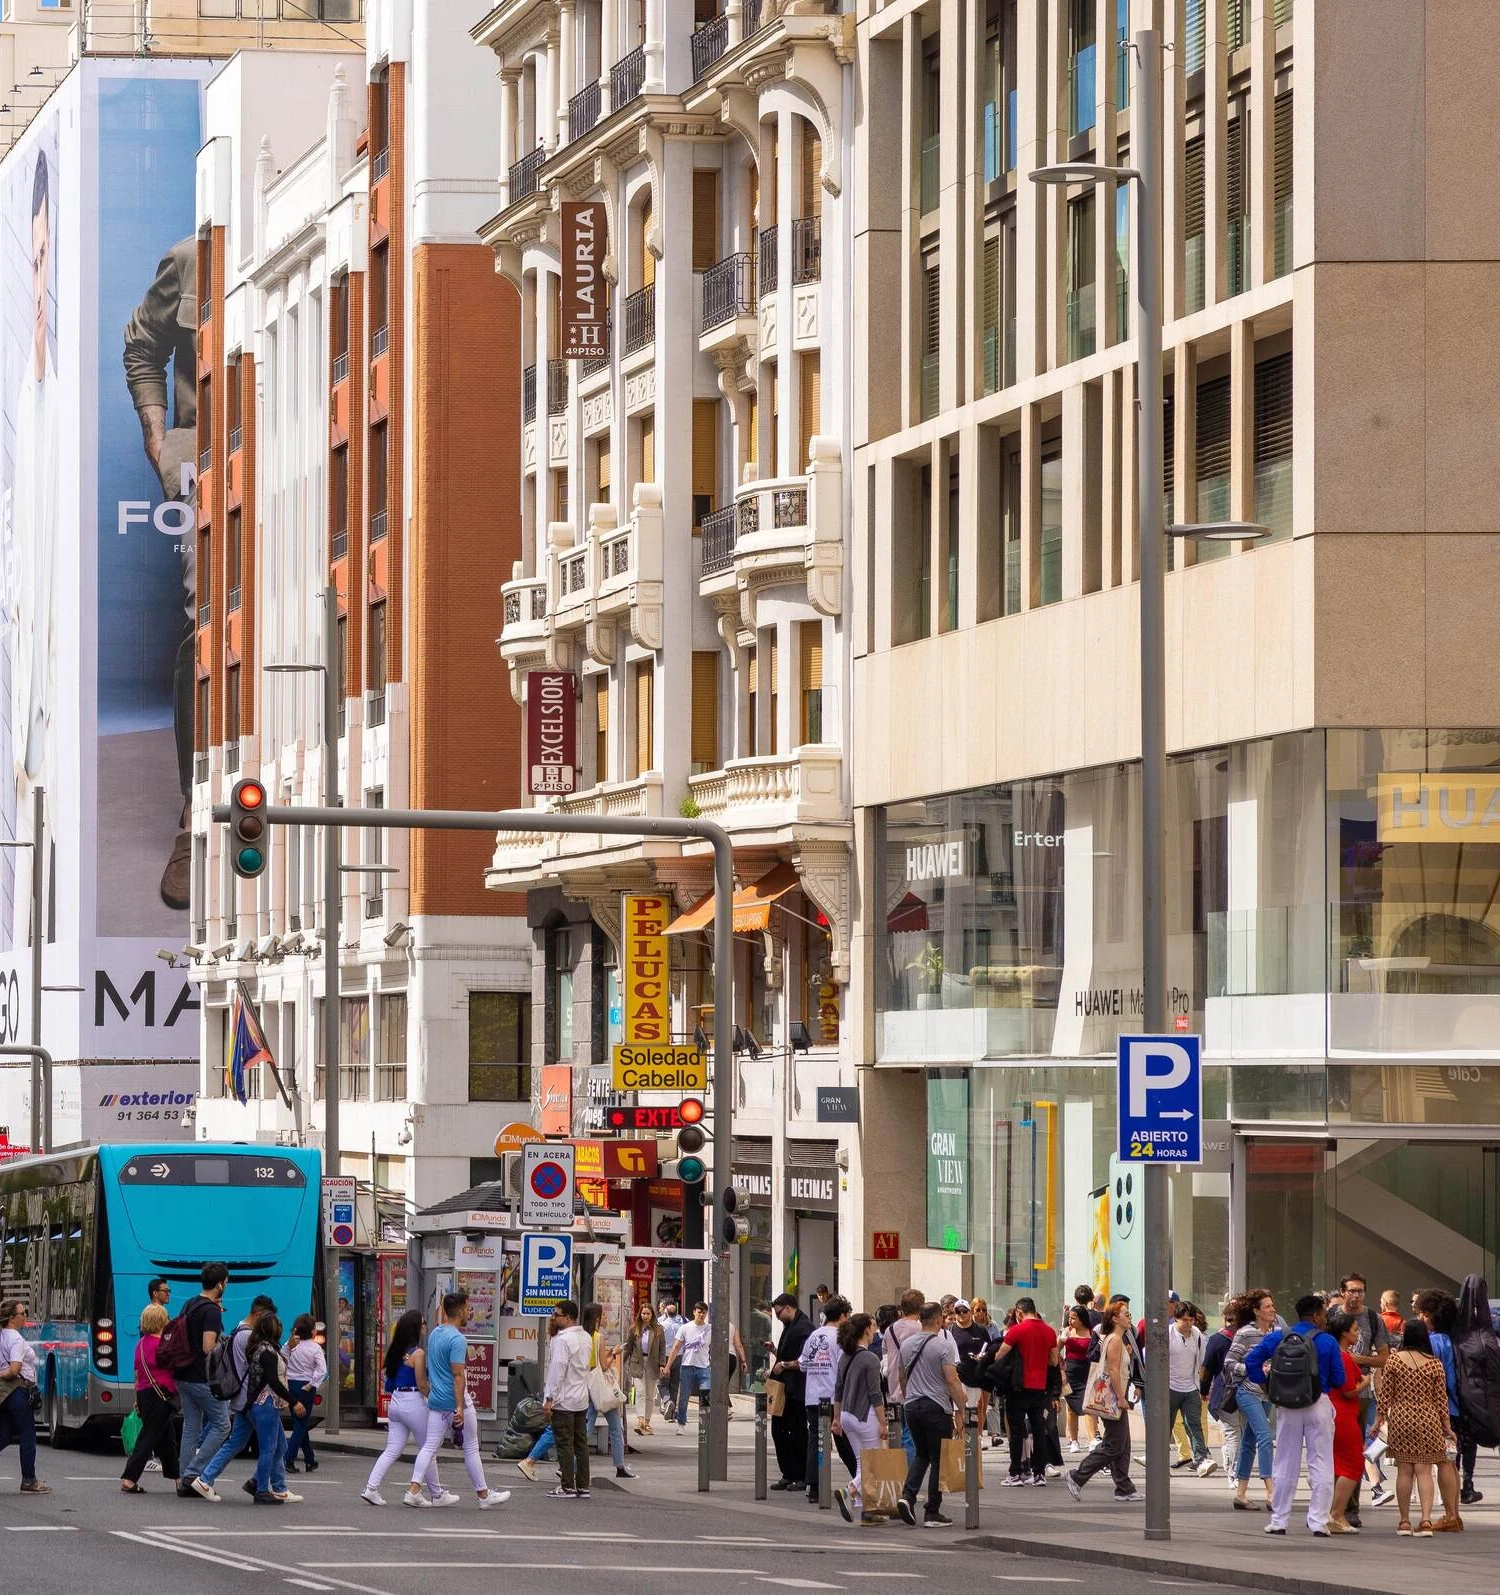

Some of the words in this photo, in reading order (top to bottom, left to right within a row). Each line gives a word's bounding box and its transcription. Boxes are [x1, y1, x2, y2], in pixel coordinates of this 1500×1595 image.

[576, 208, 595, 319] LAURIA
[541, 676, 564, 764] EXCELSIOR
[906, 841, 964, 881] HUAWEI
[632, 899, 663, 1040] PELUCAS
[95, 970, 201, 1026] MA
[1075, 989, 1124, 1017] HUAWEI
[1173, 987, 1190, 1014] Pro
[619, 1049, 700, 1066] Soledad
[622, 1070, 698, 1087] Cabello
[119, 1090, 194, 1106] exterior
[826, 1103, 848, 1111] VIEW
[117, 1111, 132, 1121] 91
[136, 1111, 160, 1121] 364
[163, 1111, 179, 1120] 53
[931, 1132, 956, 1156] GRAN
[1130, 1131, 1188, 1142] ABIERTO
[1130, 1142, 1155, 1157] 24
[1156, 1149, 1188, 1158] HORAS
[254, 1167, 275, 1178] 132
[937, 1159, 964, 1184] VIEW
[791, 1178, 833, 1200] DECIMAS
[876, 1234, 897, 1249] AT
[539, 1289, 568, 1297] MULTAS
